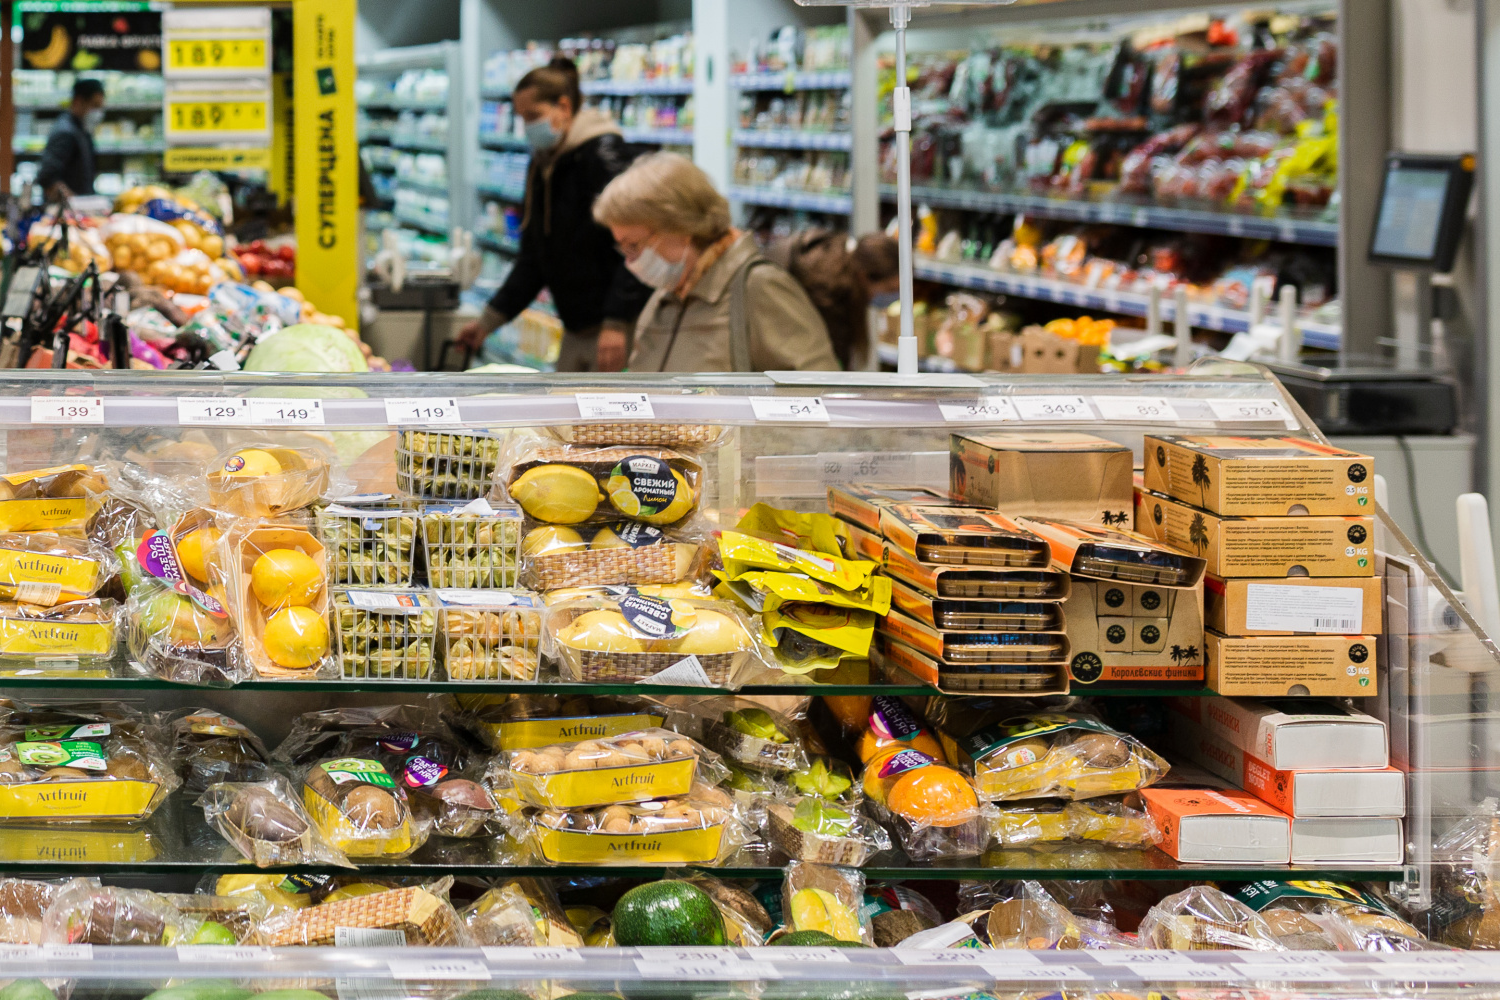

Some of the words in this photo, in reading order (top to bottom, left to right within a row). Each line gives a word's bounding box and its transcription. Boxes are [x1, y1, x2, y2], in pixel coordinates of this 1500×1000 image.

[57, 406, 89, 417] 139
[204, 406, 236, 417] 129
[276, 408, 308, 419] 149
[412, 407, 444, 418] 119
[622, 403, 638, 412] 99
[790, 404, 812, 415] 54
[966, 405, 1000, 415] 349
[1042, 404, 1076, 414] 349
[1238, 406, 1273, 416] 579
[633, 477, 676, 489] СВЕЖИЙ
[633, 487, 675, 496] АРОМАТНЫЙ
[1356, 486, 1368, 494] KG
[642, 494, 668, 503] Лимон
[40, 507, 72, 517] Artfruit
[1356, 547, 1368, 555] KG
[14, 559, 65, 576] Artfruit
[624, 600, 668, 620] СВЕЖИЙ
[628, 596, 671, 612] АРОМАТНЫЙ
[28, 627, 80, 642] Artfruit
[1075, 654, 1100, 668] DELIGHT
[1111, 667, 1163, 679] Королевские
[1165, 667, 1197, 679] финики
[1358, 666, 1370, 675] KG
[1207, 702, 1240, 733] ФИНИКИ
[558, 723, 607, 738] Artfruit
[411, 763, 434, 781] МЕНЯ
[413, 757, 438, 776] СЪЕШЬ
[1248, 760, 1271, 782] DEGLET
[611, 772, 655, 789] Artfruit
[1248, 773, 1266, 791] NOUR
[36, 788, 88, 803] Artfruit
[606, 839, 663, 852] Artfruit
